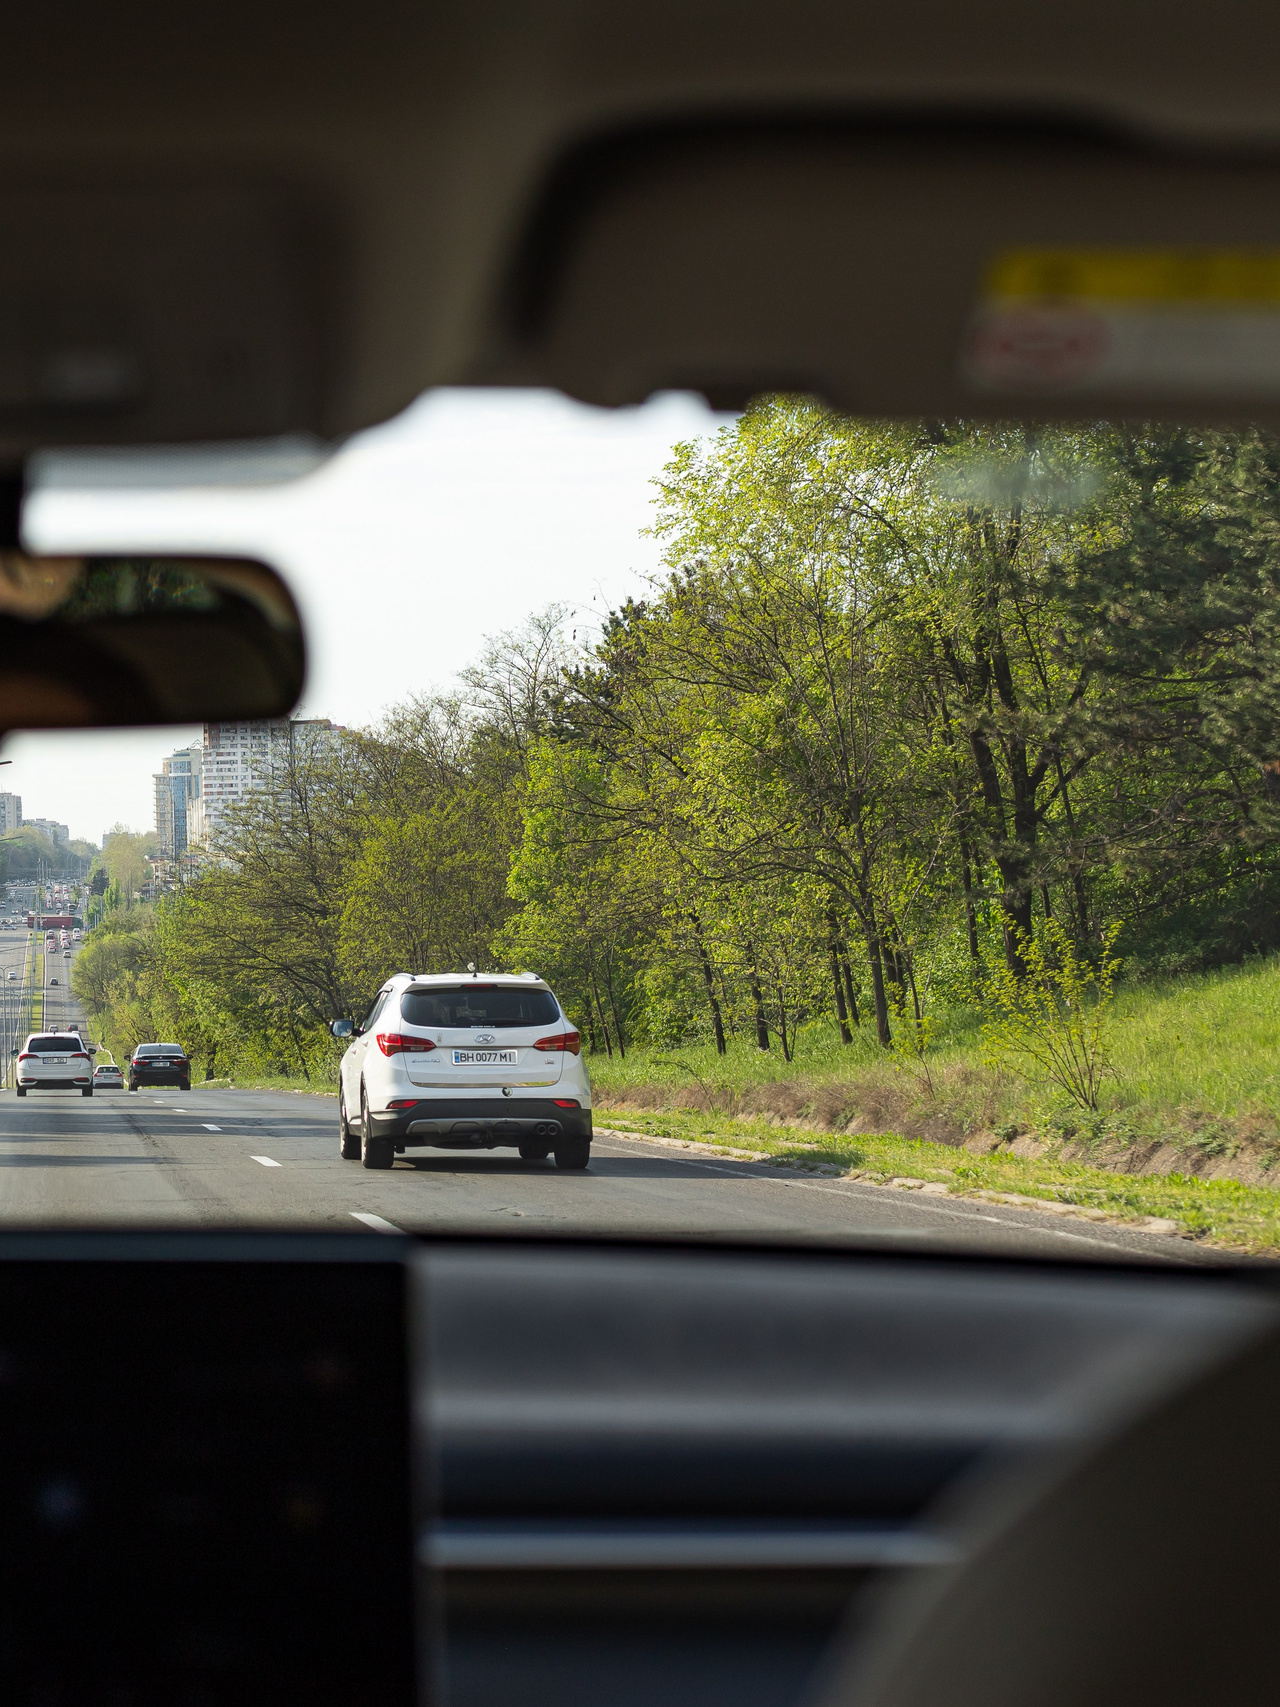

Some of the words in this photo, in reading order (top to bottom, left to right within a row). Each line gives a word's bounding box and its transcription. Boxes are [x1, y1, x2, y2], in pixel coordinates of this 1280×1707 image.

[459, 1052, 474, 1062] BH
[476, 1052, 497, 1062] 0077
[500, 1052, 512, 1062] MI
